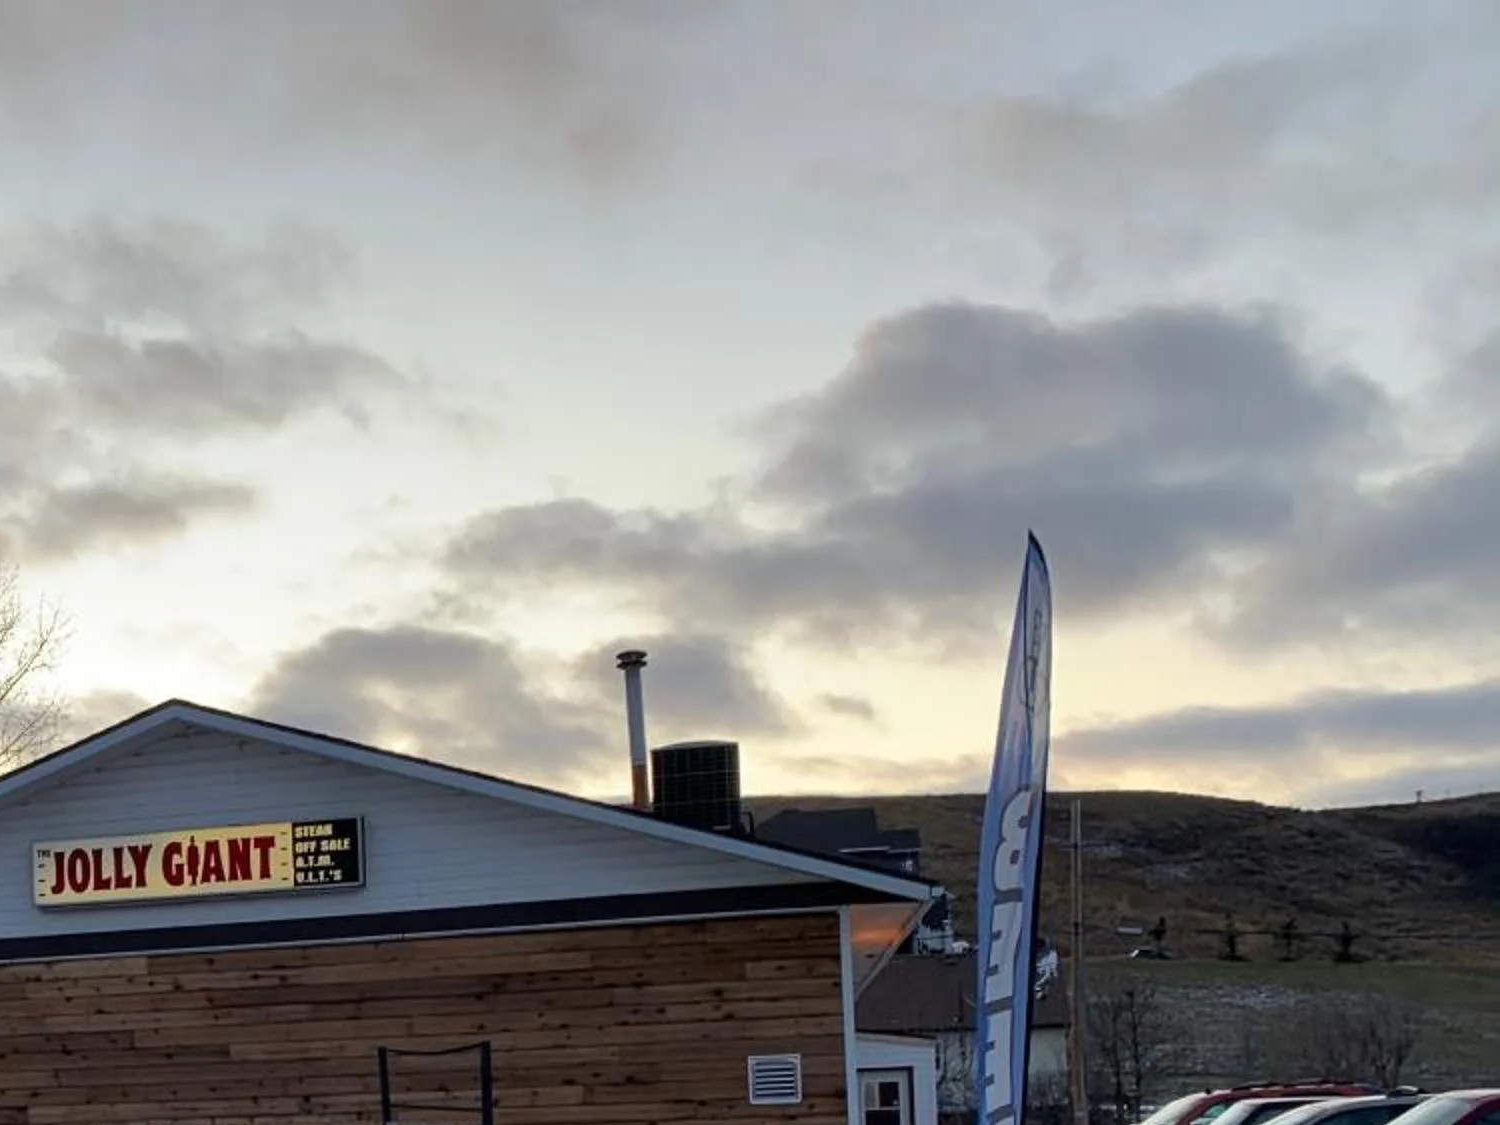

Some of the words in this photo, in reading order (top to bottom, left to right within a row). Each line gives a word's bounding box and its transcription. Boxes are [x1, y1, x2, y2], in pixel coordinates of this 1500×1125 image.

[295, 840, 317, 854] OFF
[320, 837, 351, 852] SALE
[50, 844, 153, 895] JOLLY
[162, 835, 275, 887] GIANT
